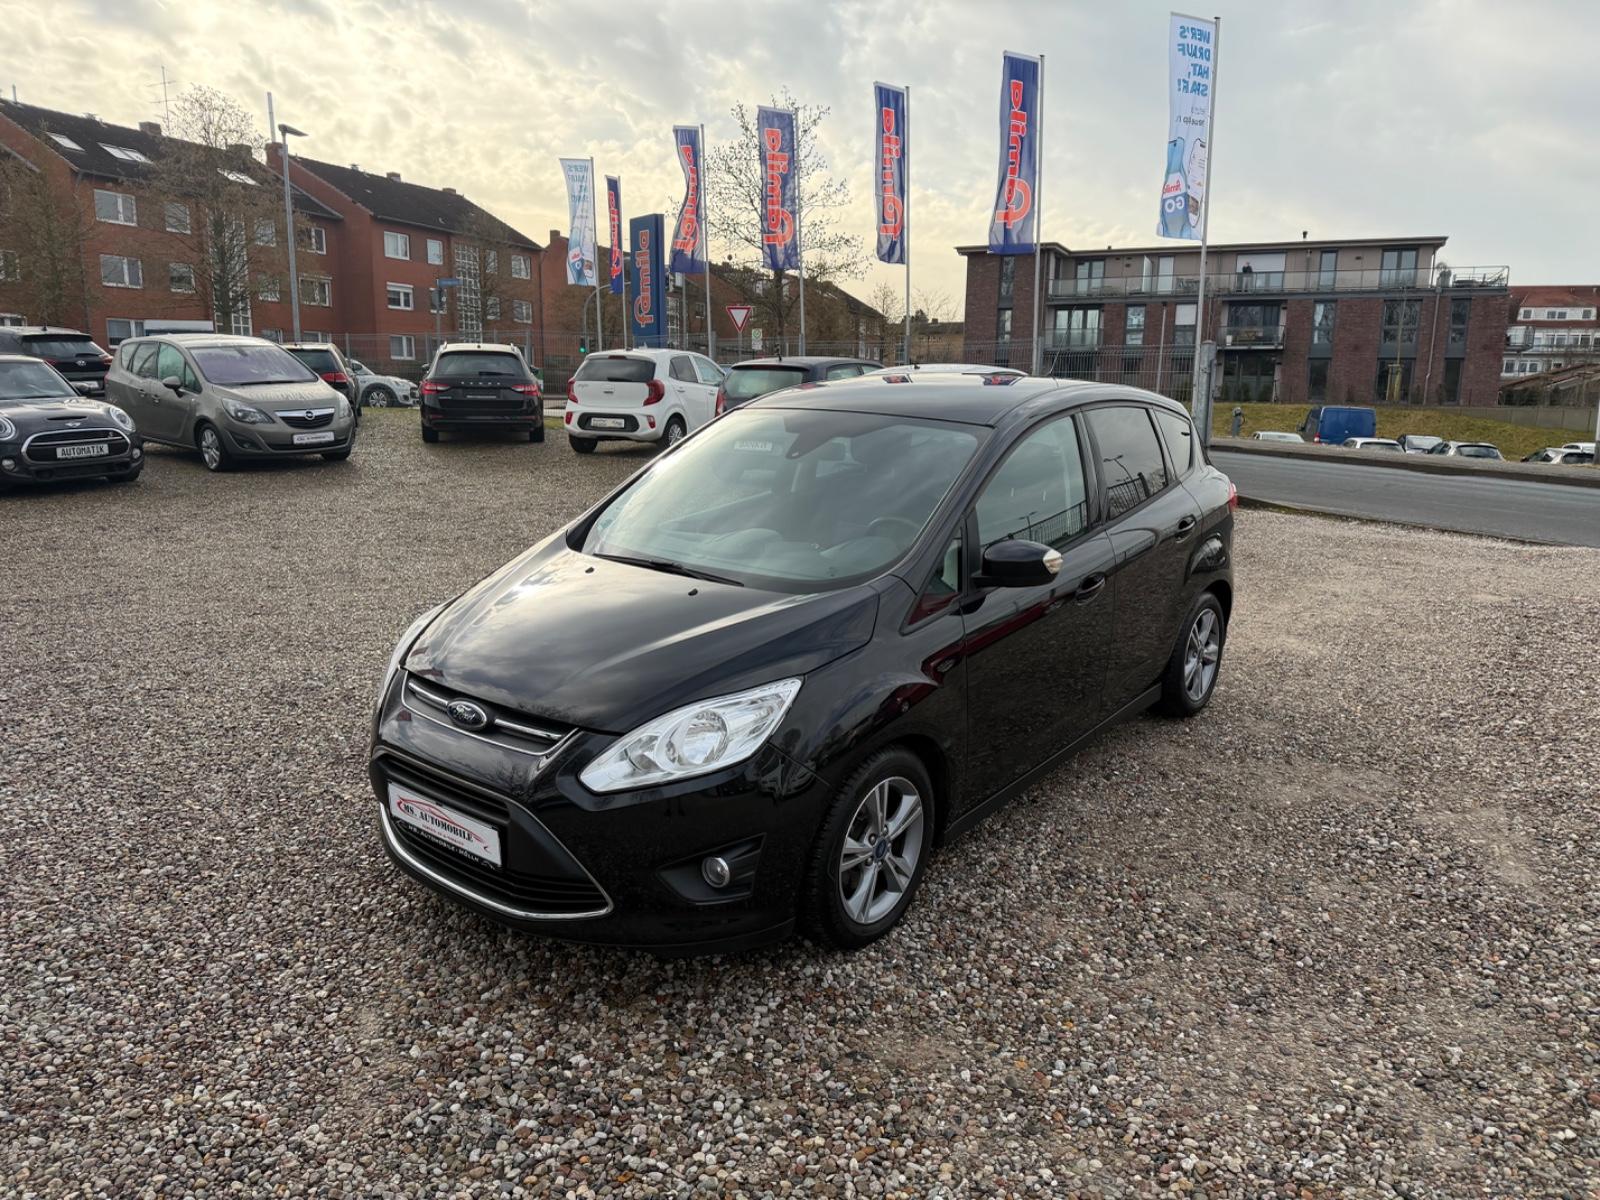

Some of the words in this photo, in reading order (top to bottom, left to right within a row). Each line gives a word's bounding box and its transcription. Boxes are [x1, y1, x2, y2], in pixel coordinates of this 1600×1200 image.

[634, 230, 653, 327] famila
[61, 446, 104, 456] AUTOMATIK
[419, 811, 474, 842] AUTOMOBILE
